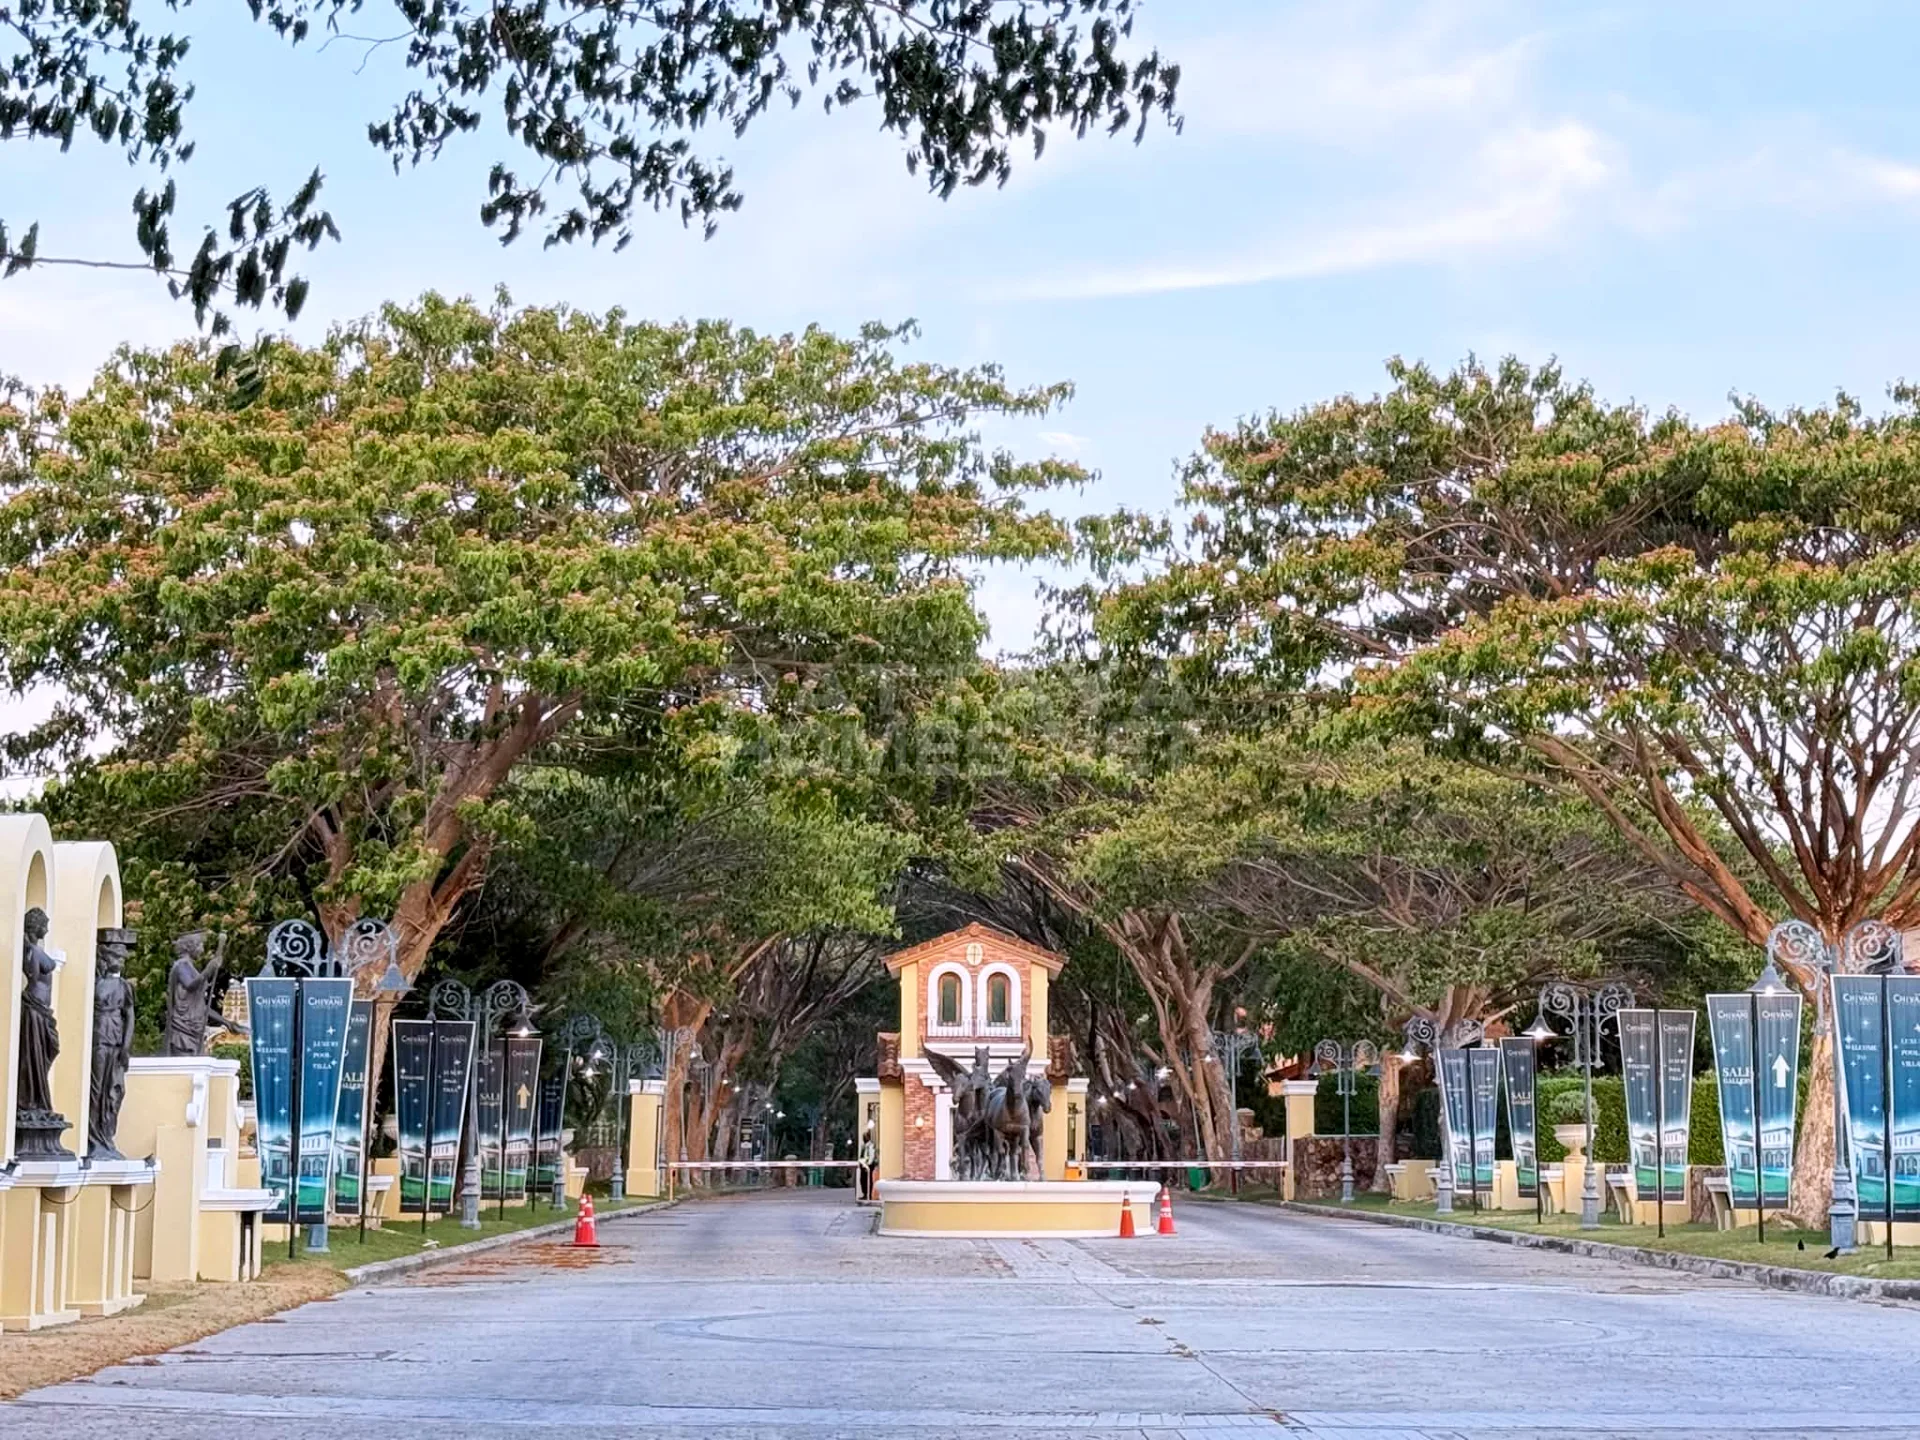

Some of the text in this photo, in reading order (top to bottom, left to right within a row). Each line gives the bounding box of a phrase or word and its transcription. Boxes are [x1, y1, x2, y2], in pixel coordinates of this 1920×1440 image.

[256, 996, 290, 1005] CHIVANI
[308, 996, 343, 1006] CHIVANI
[1842, 993, 1878, 1002] CHIVANI
[1717, 1010, 1749, 1019] CHIVANI
[1762, 1010, 1793, 1019] CHIVANI
